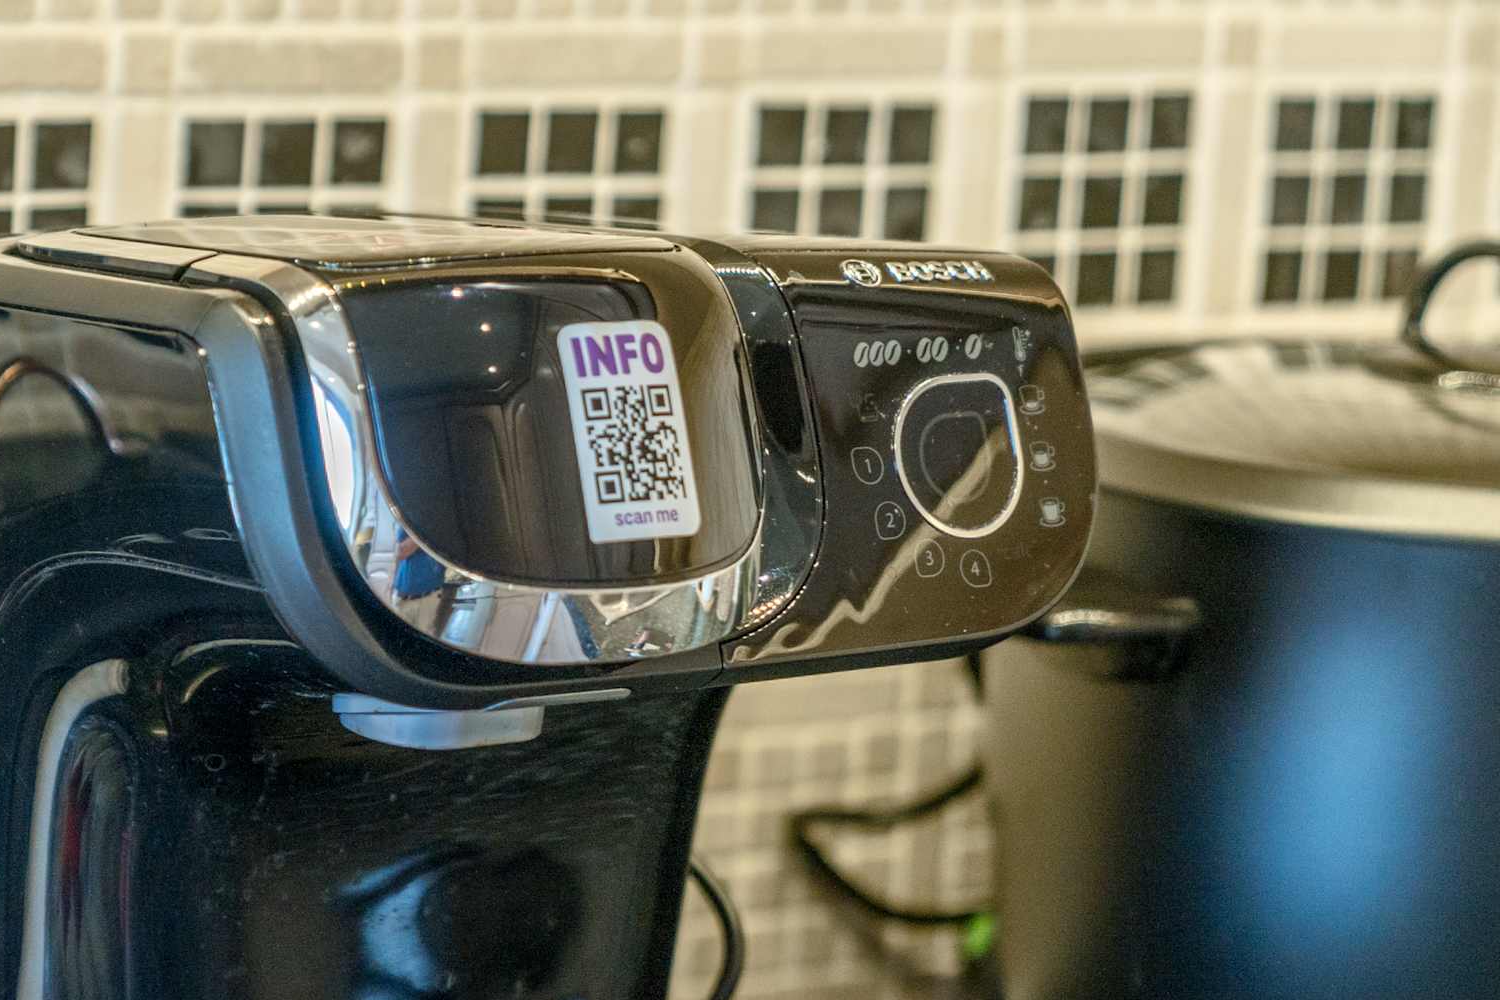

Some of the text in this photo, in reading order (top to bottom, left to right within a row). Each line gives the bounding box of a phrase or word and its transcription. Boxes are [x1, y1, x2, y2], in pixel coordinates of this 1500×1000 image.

[884, 260, 995, 283] BOSCH
[569, 332, 665, 378] INFO
[863, 457, 873, 474] 1
[614, 508, 679, 527] scan me
[884, 512, 896, 529] 2
[924, 550, 935, 567] 3
[970, 560, 981, 577] 4
